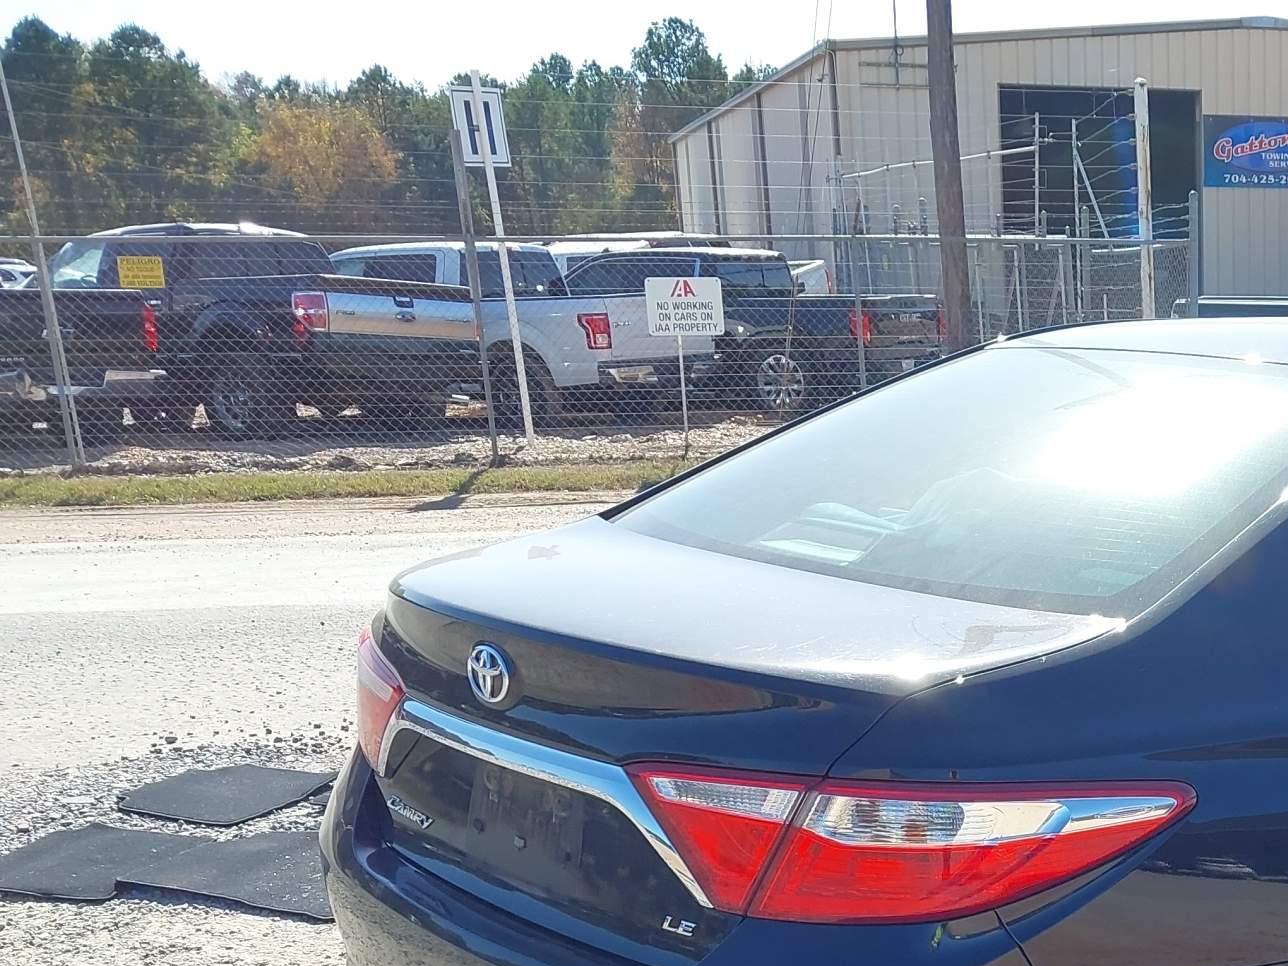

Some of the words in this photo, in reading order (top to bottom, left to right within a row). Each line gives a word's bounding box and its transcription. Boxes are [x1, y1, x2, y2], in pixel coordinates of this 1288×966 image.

[656, 301, 669, 311] NO
[672, 301, 714, 311] WORKING
[658, 312, 671, 321] ON
[674, 312, 698, 321] CARS
[700, 312, 713, 321] ON
[655, 322, 670, 333] IAA
[673, 322, 718, 332] PROPERTY
[386, 794, 433, 829] CAMRY
[662, 915, 697, 937] LE
